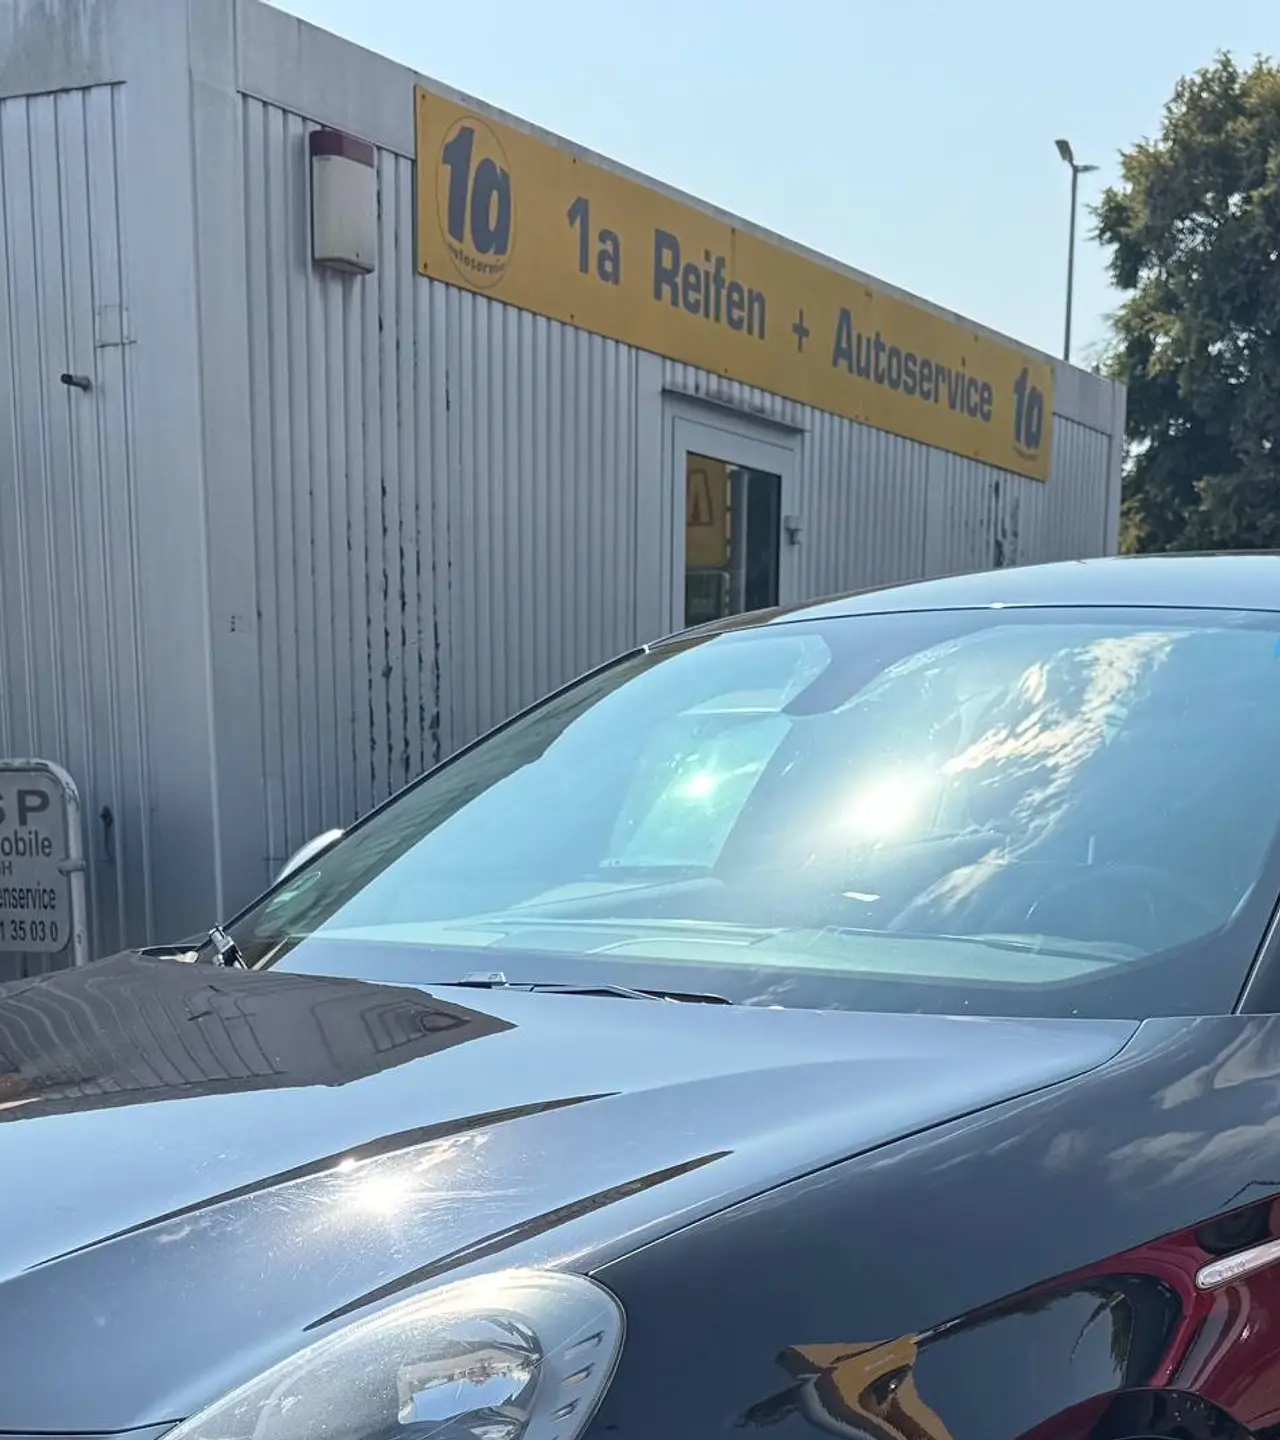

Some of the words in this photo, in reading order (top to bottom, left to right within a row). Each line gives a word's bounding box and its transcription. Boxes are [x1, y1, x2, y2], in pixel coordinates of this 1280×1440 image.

[442, 125, 512, 255] 1a
[567, 196, 620, 286] 1a
[653, 228, 766, 340] Reifen
[792, 308, 810, 352] +
[832, 307, 993, 422] Autoservice
[1014, 367, 1044, 449] 1a
[11, 919, 27, 941] 35
[30, 920, 46, 942] 03
